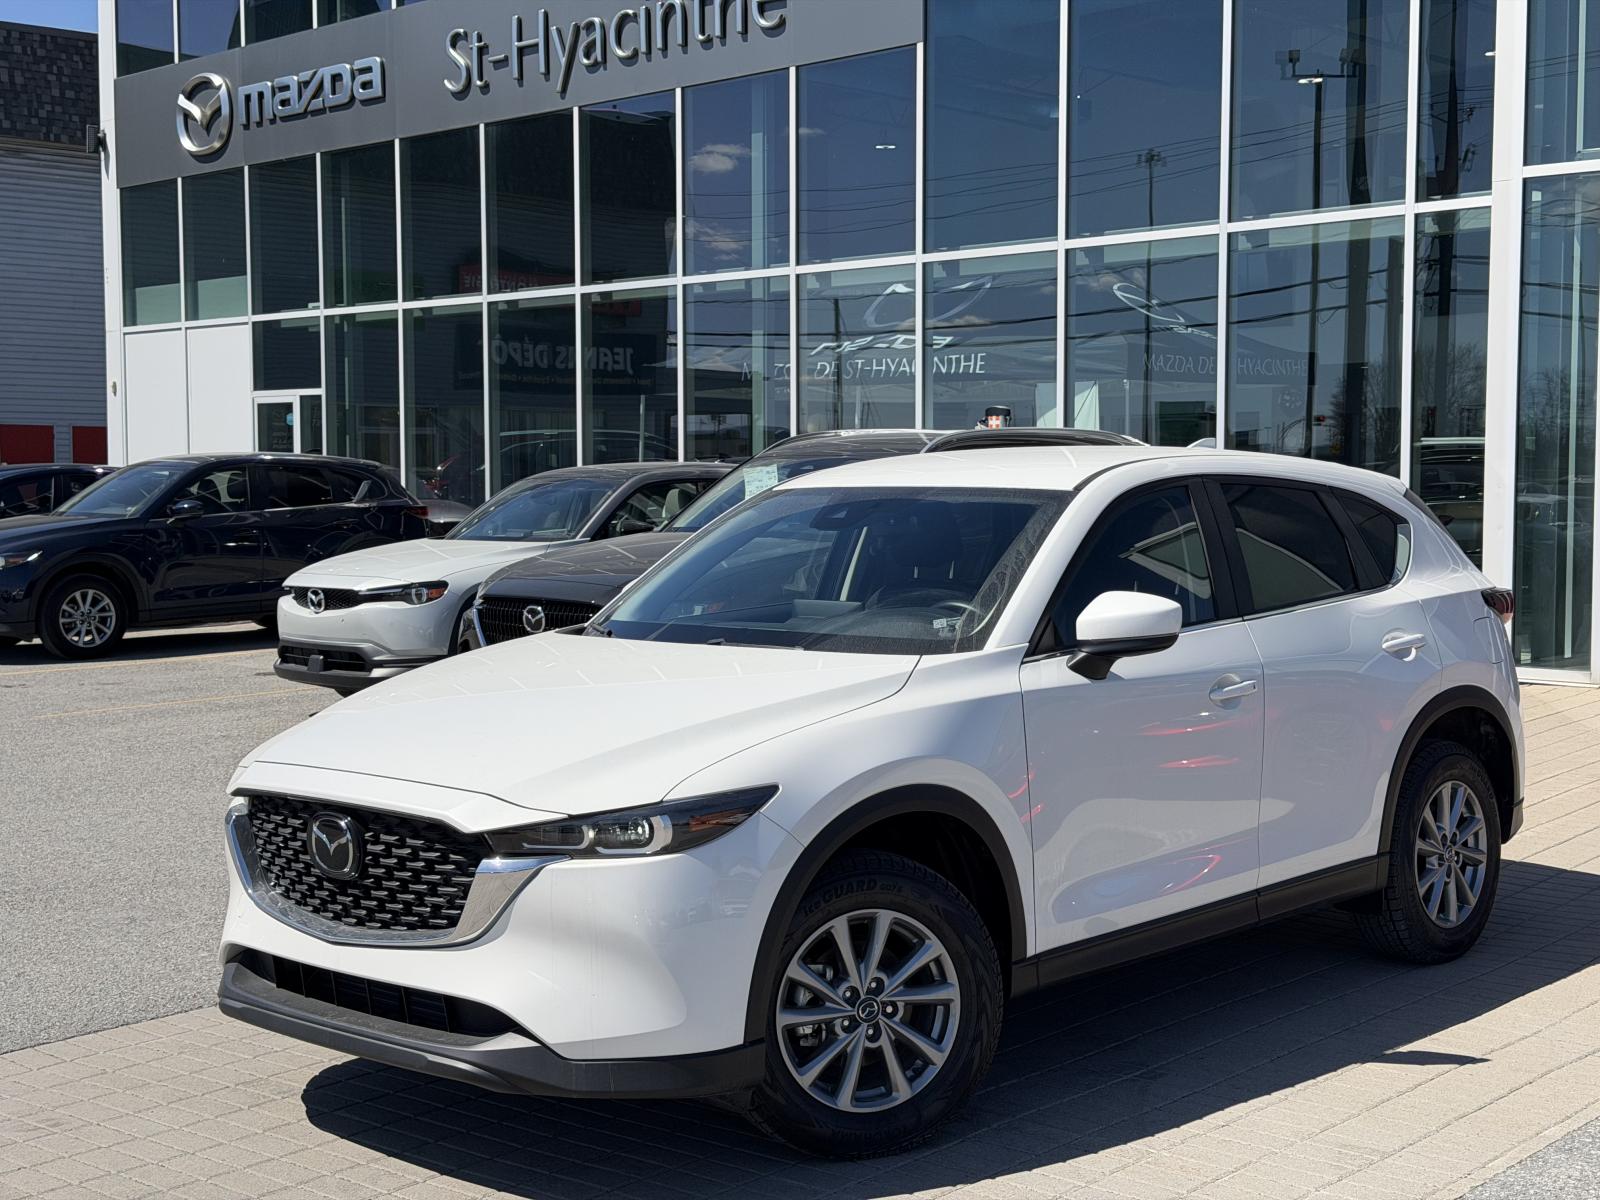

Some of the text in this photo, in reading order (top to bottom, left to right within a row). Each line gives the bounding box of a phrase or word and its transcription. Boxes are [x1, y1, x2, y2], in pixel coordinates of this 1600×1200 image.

[237, 55, 384, 126] mazda
[814, 361, 840, 380] DE
[843, 353, 986, 379] ST-HYANTHE
[1144, 352, 1195, 374] MAZDA
[1198, 356, 1217, 375] DE
